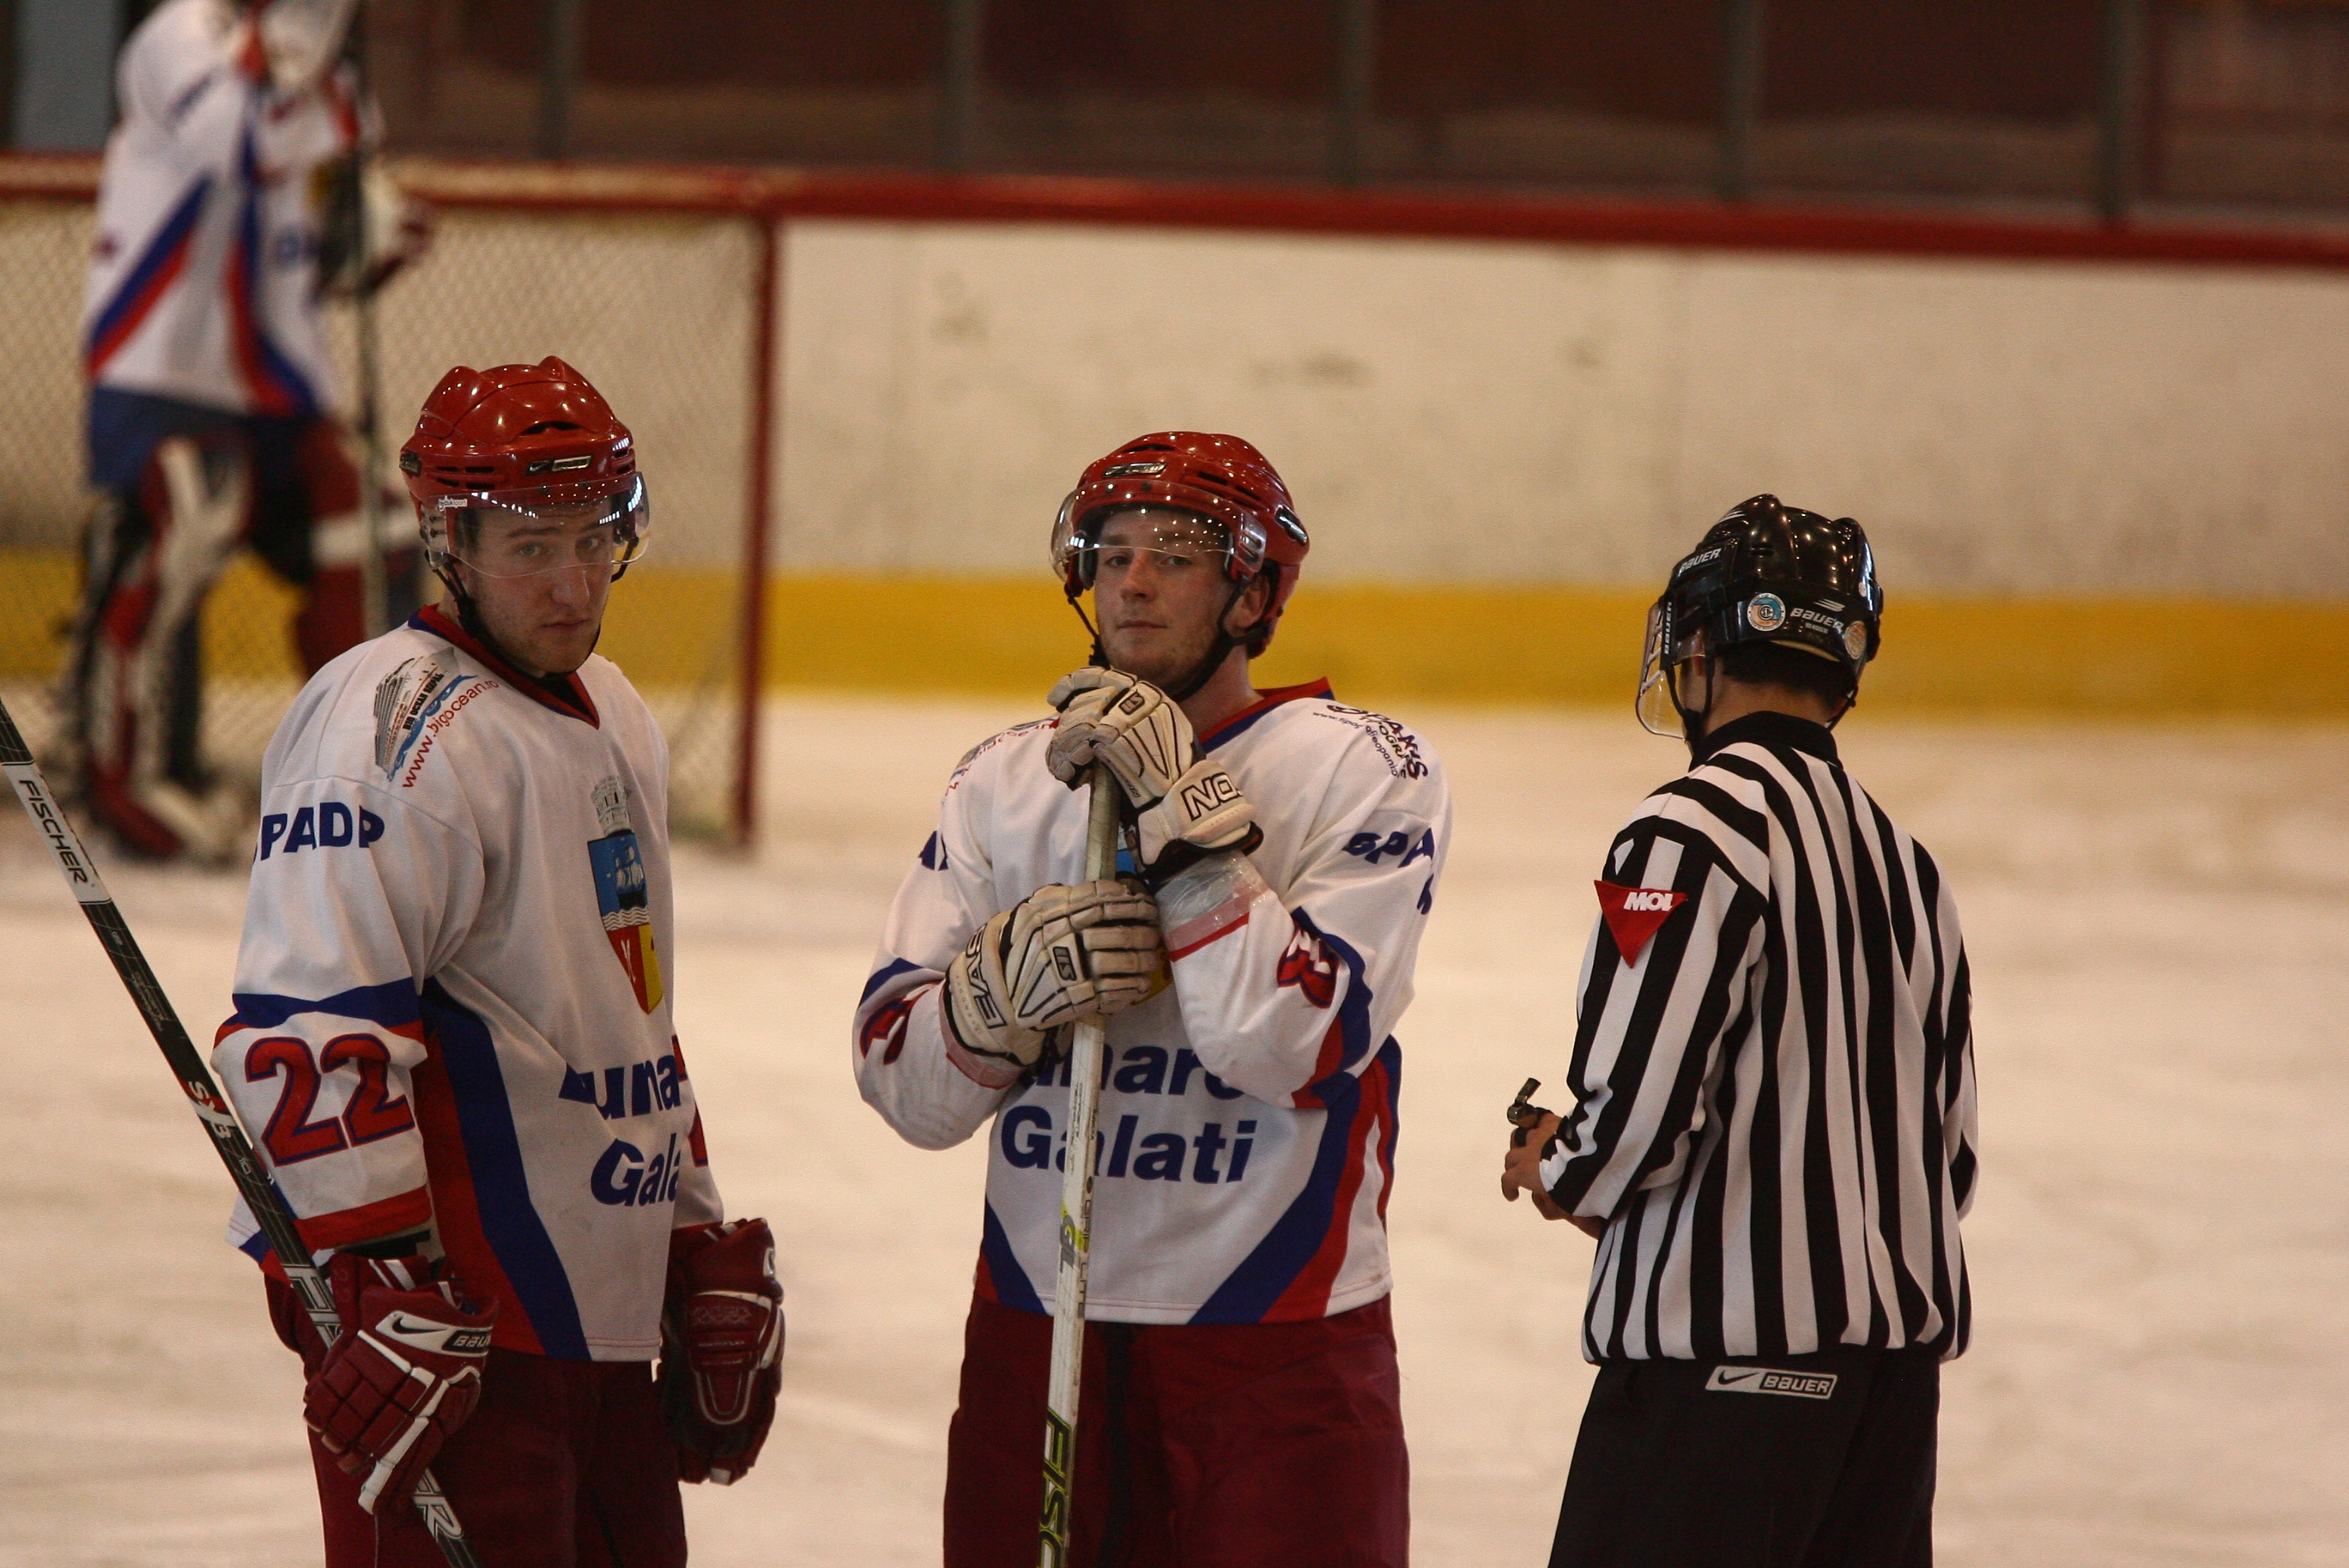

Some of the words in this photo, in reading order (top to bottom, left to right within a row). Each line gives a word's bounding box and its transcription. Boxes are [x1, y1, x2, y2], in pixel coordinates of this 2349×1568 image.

[1790, 608, 1844, 632] BAUER
[18, 779, 88, 883] FISCHER
[1623, 891, 1673, 912] MOL
[244, 1033, 415, 1168] 22
[1763, 1374, 1831, 1394] BAUER
